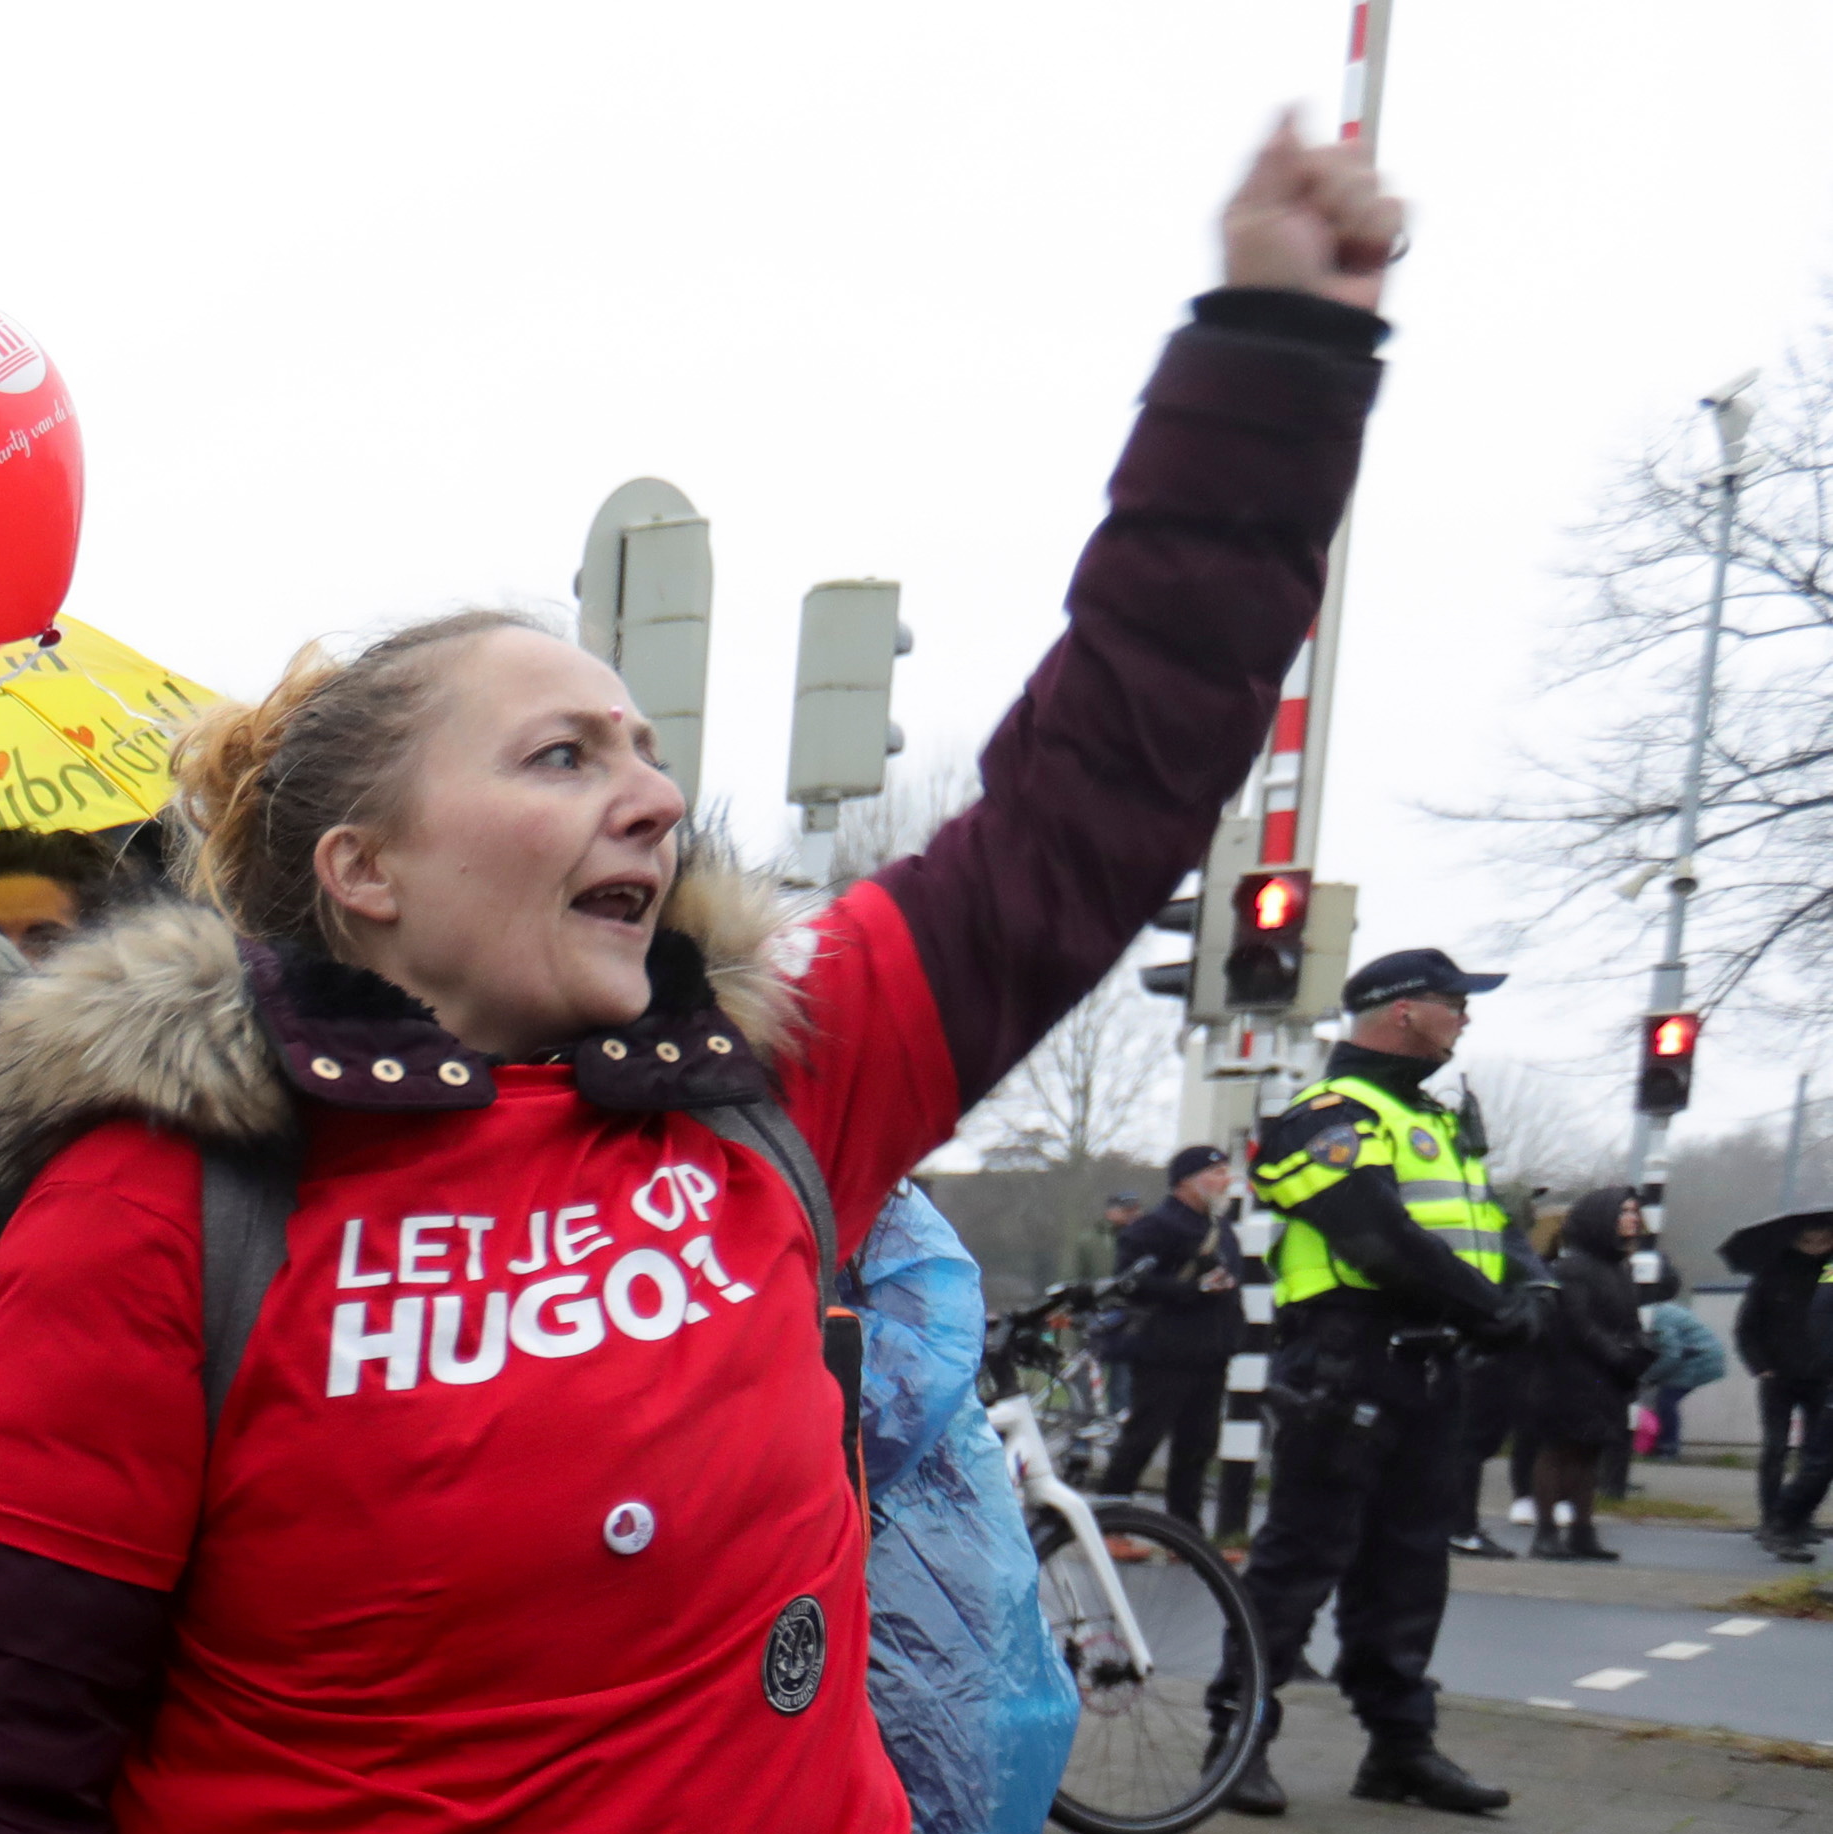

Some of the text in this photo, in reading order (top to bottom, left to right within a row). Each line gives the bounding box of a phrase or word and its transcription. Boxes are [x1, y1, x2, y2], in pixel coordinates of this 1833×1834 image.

[30, 416, 54, 438] van
[336, 1163, 718, 1289] LET JE OP
